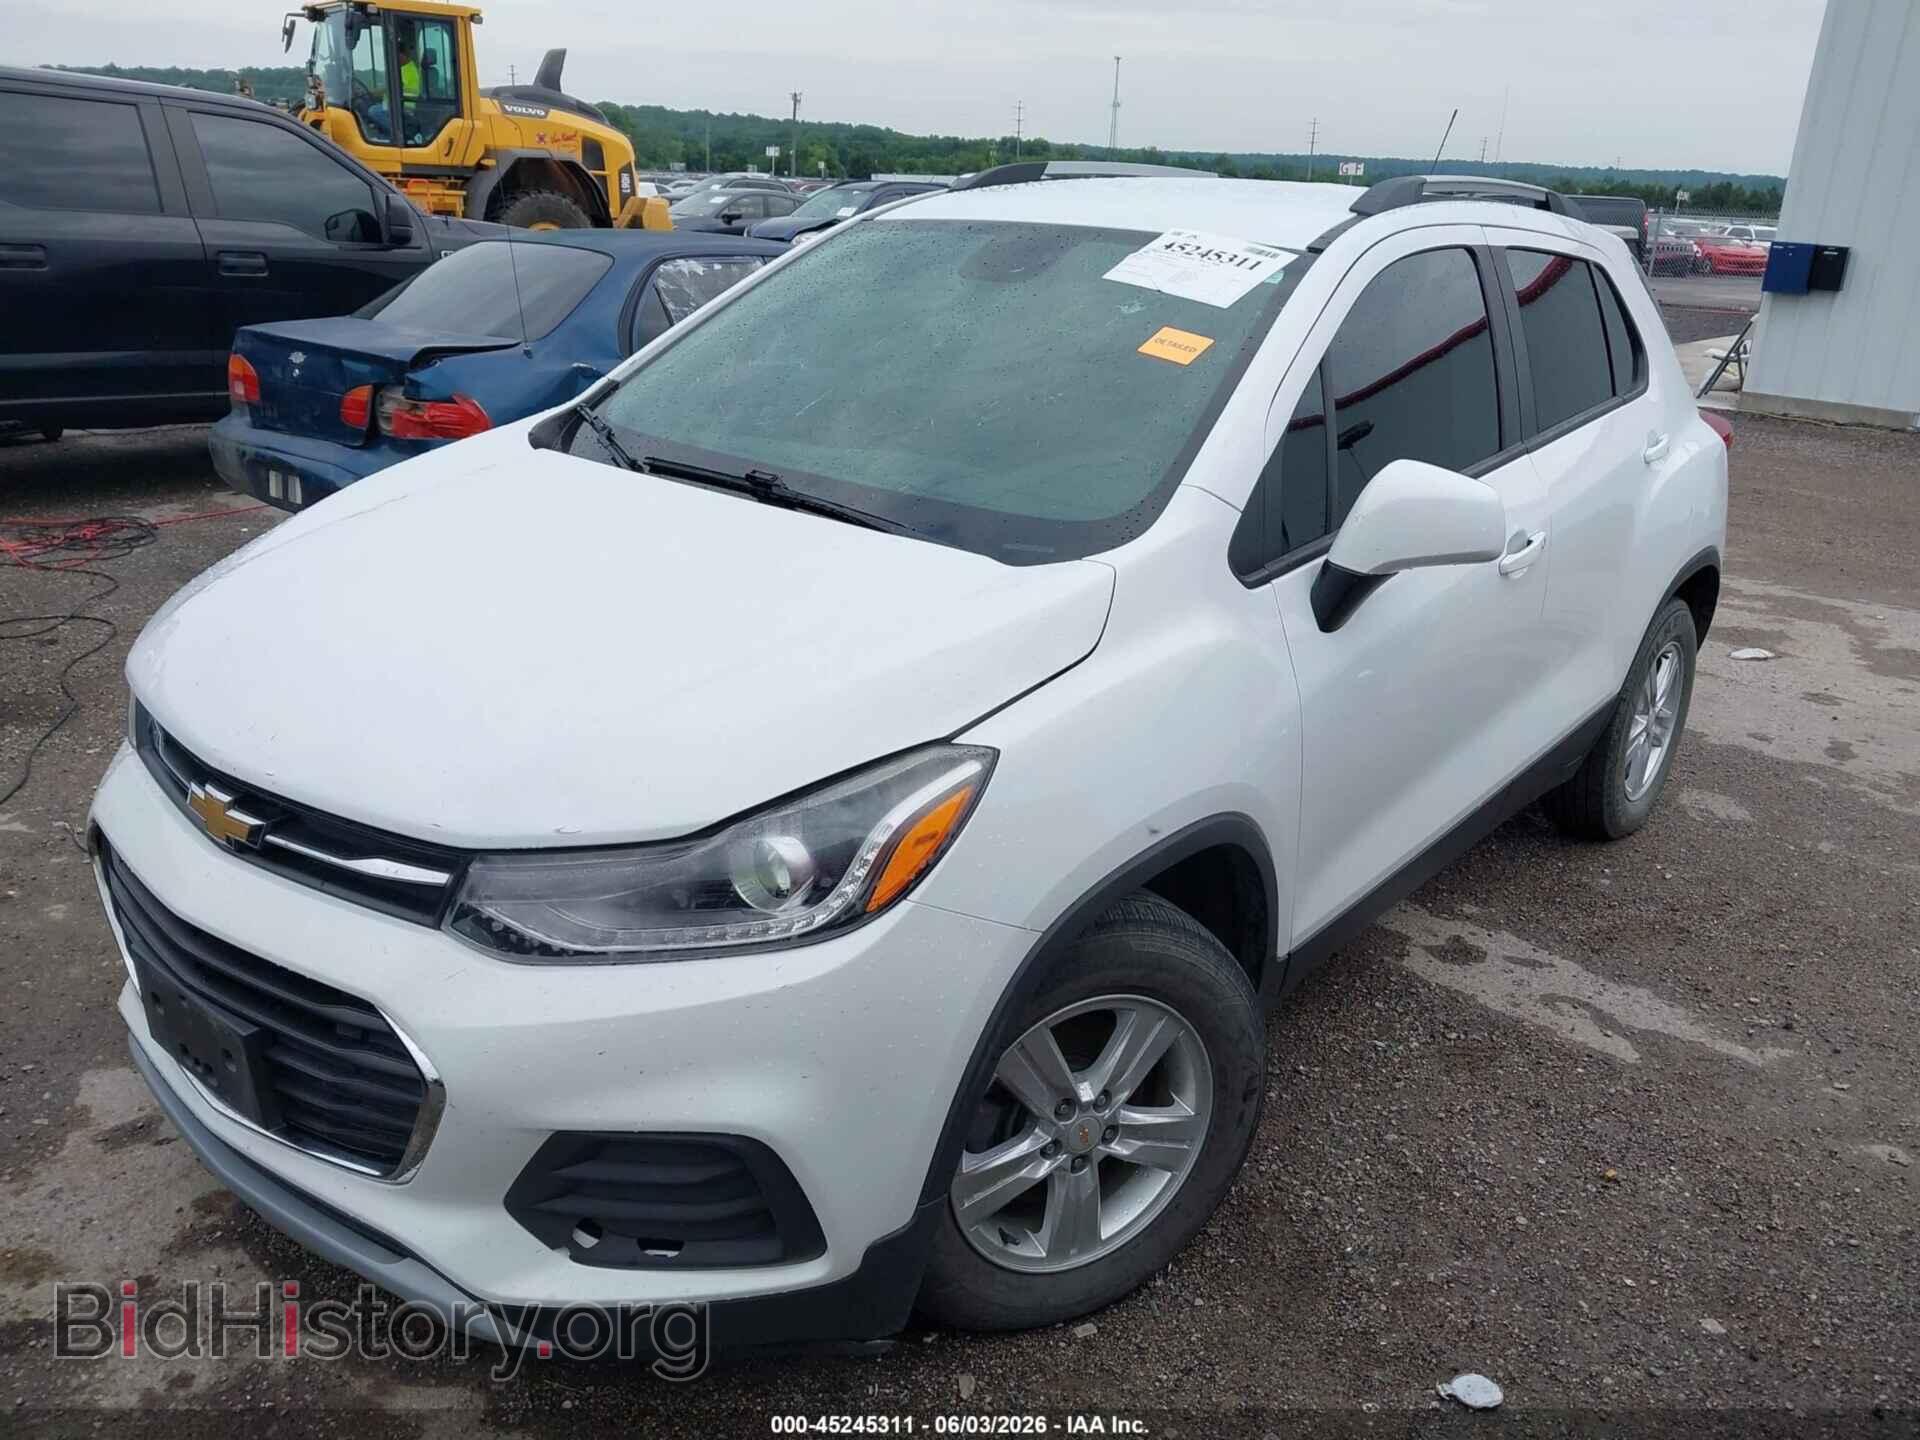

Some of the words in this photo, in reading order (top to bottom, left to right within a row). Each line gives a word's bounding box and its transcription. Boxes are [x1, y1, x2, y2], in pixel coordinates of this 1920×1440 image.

[504, 104, 545, 116] VOLVO
[1163, 241, 1262, 271] 45245311
[1153, 337, 1198, 353] DETAILED
